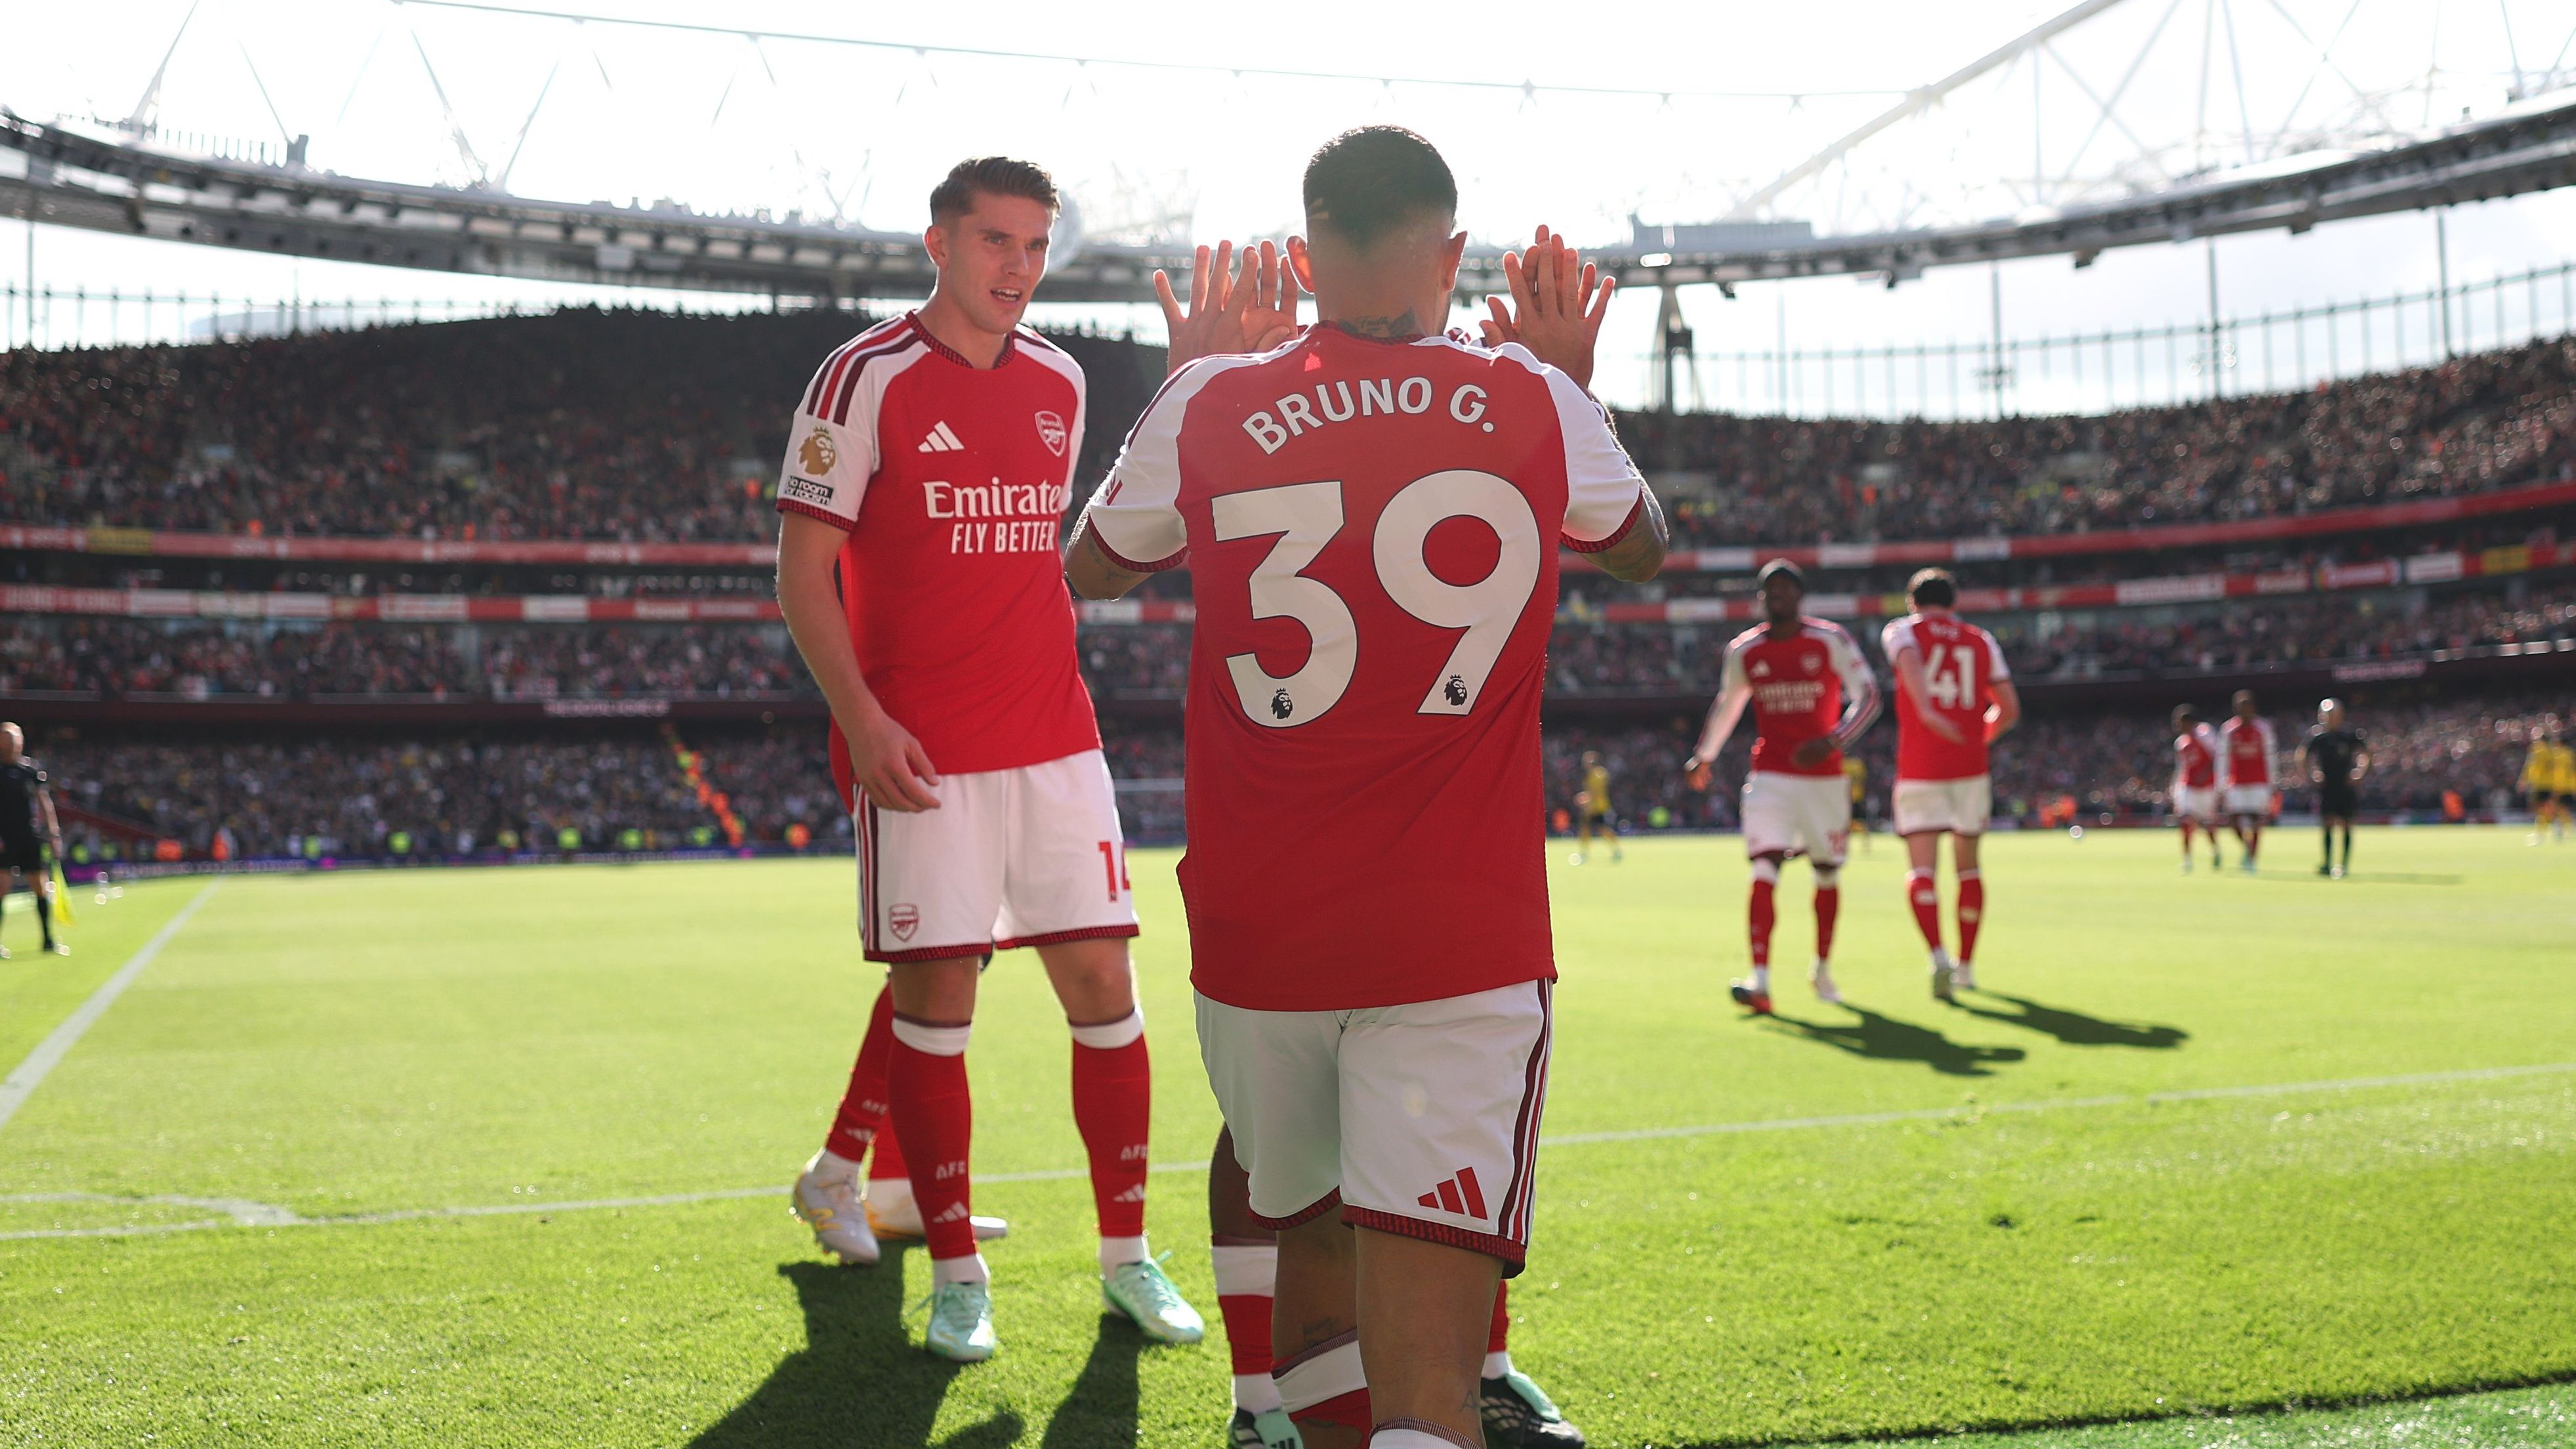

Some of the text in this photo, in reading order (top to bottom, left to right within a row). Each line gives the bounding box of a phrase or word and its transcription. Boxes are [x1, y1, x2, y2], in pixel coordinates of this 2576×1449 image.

[1242, 377, 1495, 455] BRUNO G.
[799, 481, 828, 496] room
[923, 476, 1060, 519] Emirate
[951, 520, 1056, 555] FLY BETTER
[1211, 469, 1541, 728] 39
[1924, 643, 1976, 710] 41
